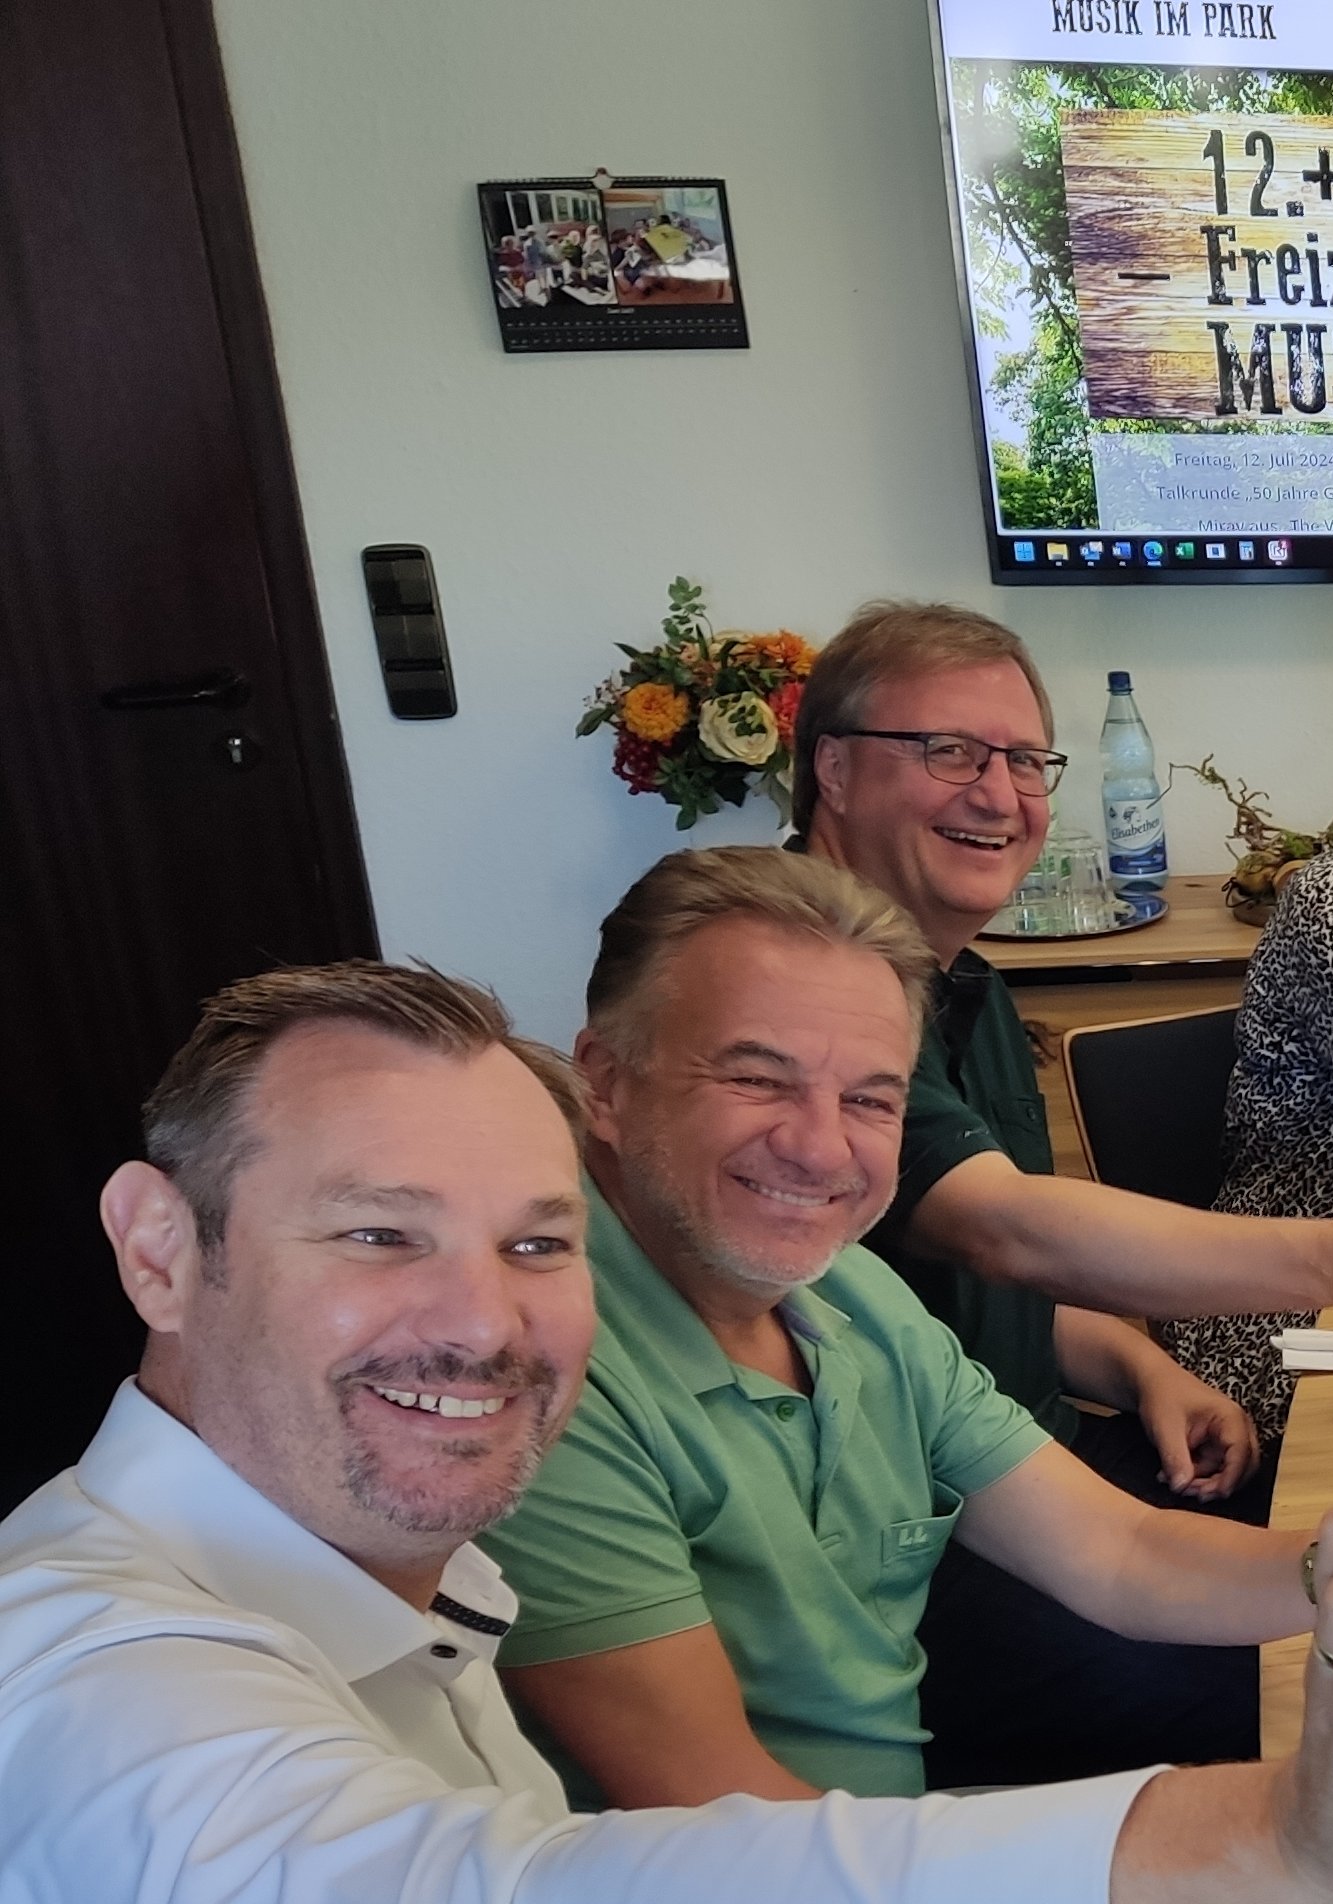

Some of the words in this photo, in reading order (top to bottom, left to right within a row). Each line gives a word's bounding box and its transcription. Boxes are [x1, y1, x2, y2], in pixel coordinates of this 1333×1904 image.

[1052, 0, 1143, 35] MUSIK
[1154, 0, 1191, 36] IM
[1202, 2, 1277, 39] PARK
[1174, 452, 1237, 470] Freitag,
[1242, 453, 1265, 467] 12.
[1269, 452, 1295, 469] Juli
[1156, 485, 1241, 501] Talkrunde
[1274, 486, 1319, 503] Jahre
[1110, 818, 1161, 840] Elisabethen
